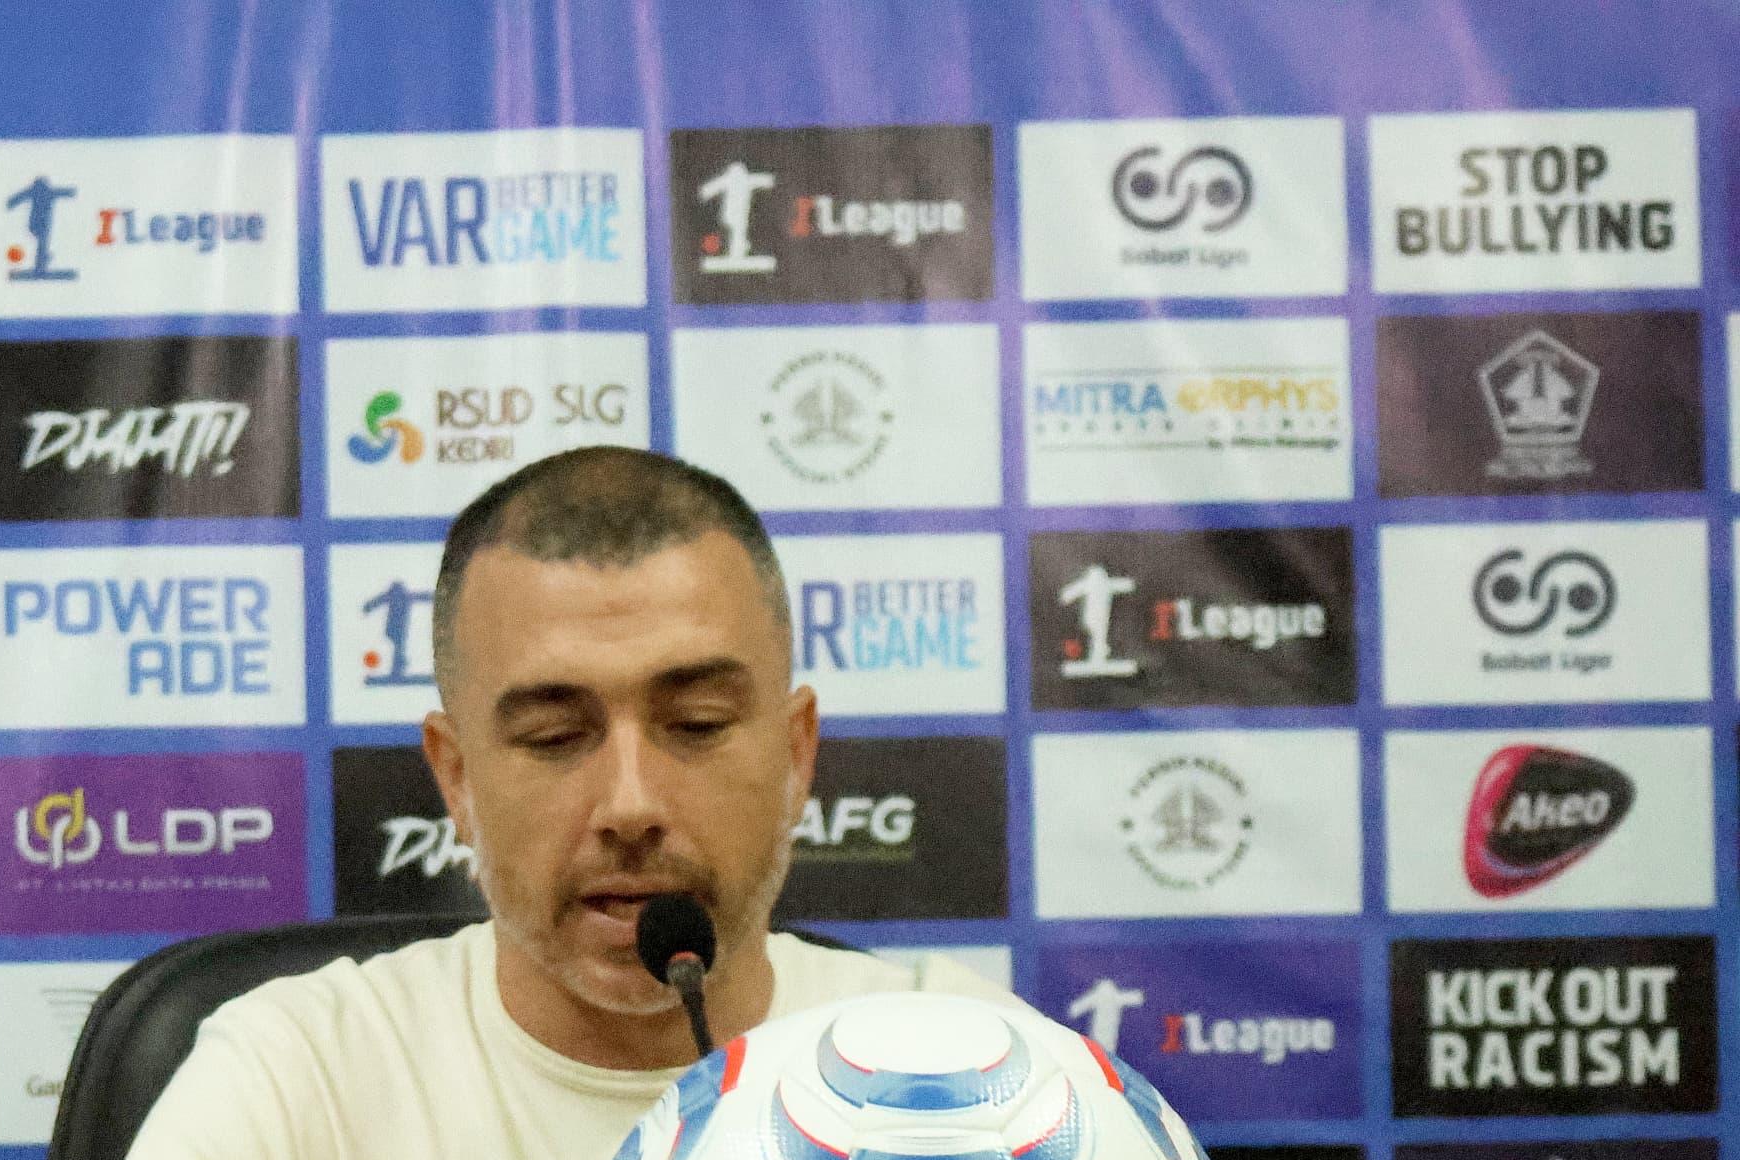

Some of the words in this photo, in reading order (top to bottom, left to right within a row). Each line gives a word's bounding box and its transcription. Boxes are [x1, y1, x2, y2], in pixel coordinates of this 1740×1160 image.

[496, 173, 619, 210] BETTER
[1461, 146, 1607, 198] STOP
[349, 177, 490, 267] VAR
[492, 208, 619, 264] GAME
[1396, 201, 1675, 257] BULLYING
[437, 386, 533, 429] RSUD
[1035, 381, 1167, 414] MITRA
[4, 577, 270, 637] POWER
[854, 578, 977, 616] BETTER
[127, 640, 270, 696] ADE
[853, 611, 979, 670] GAME
[114, 807, 274, 855] LDP
[790, 797, 914, 845] AFG
[1426, 967, 1553, 1028] KICK
[1563, 966, 1676, 1025] OUT
[1429, 1029, 1678, 1090] RACISM
